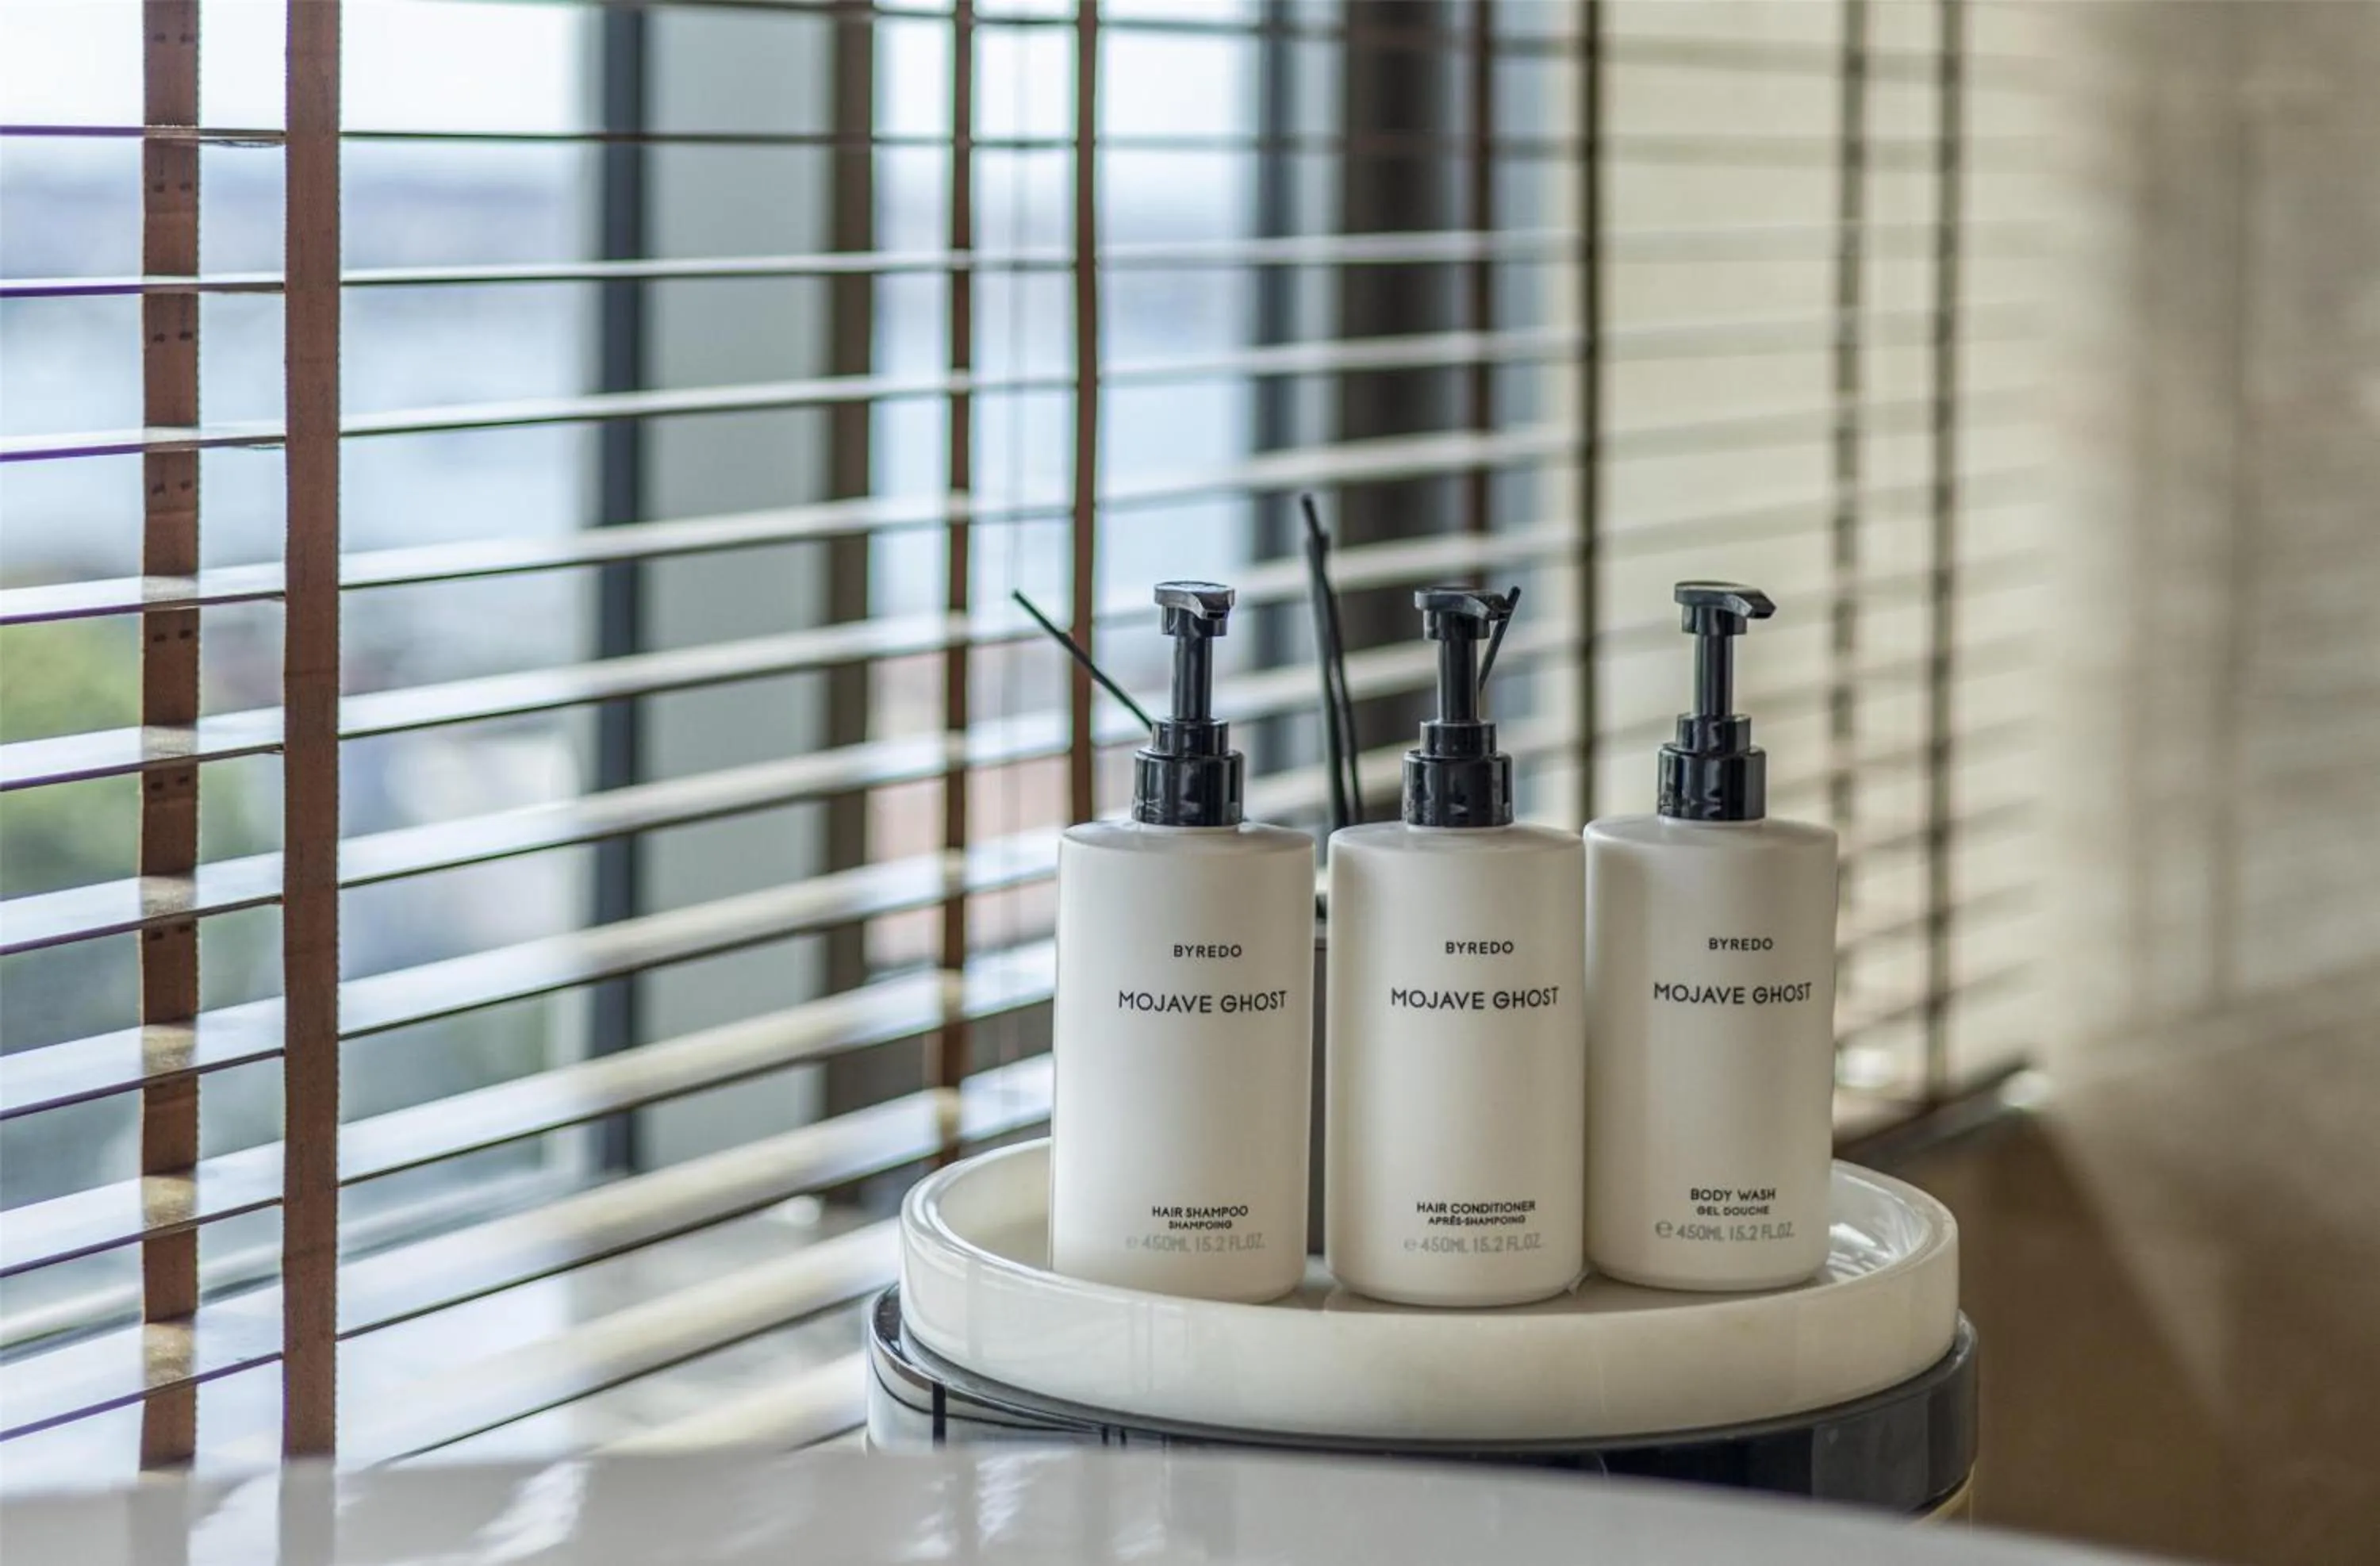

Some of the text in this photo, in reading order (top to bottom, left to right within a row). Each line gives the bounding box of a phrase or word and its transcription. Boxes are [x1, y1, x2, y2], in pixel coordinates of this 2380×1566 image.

[1173, 945, 1242, 958] BYREDO
[1445, 941, 1514, 954] BYREDO
[1709, 938, 1773, 951] BYREDO
[1392, 986, 1559, 1010] MOJAVE GHOST
[1653, 982, 1812, 1004] MOJAVE GHOST
[1119, 991, 1287, 1013] MOJAVE GHOST
[1691, 1188, 1776, 1202] BODY WASH
[1151, 1205, 1248, 1218] HAIR SHAMPOO
[1416, 1200, 1536, 1214] HAIR CONDITIONER
[1696, 1205, 1770, 1216] GEL DOUCHE
[1168, 1219, 1232, 1230] SHAMPOING
[1676, 1224, 1726, 1242] 450ML
[1729, 1225, 1758, 1242] 15.2
[1142, 1234, 1192, 1252] 450ML
[1421, 1236, 1468, 1253] 450ML
